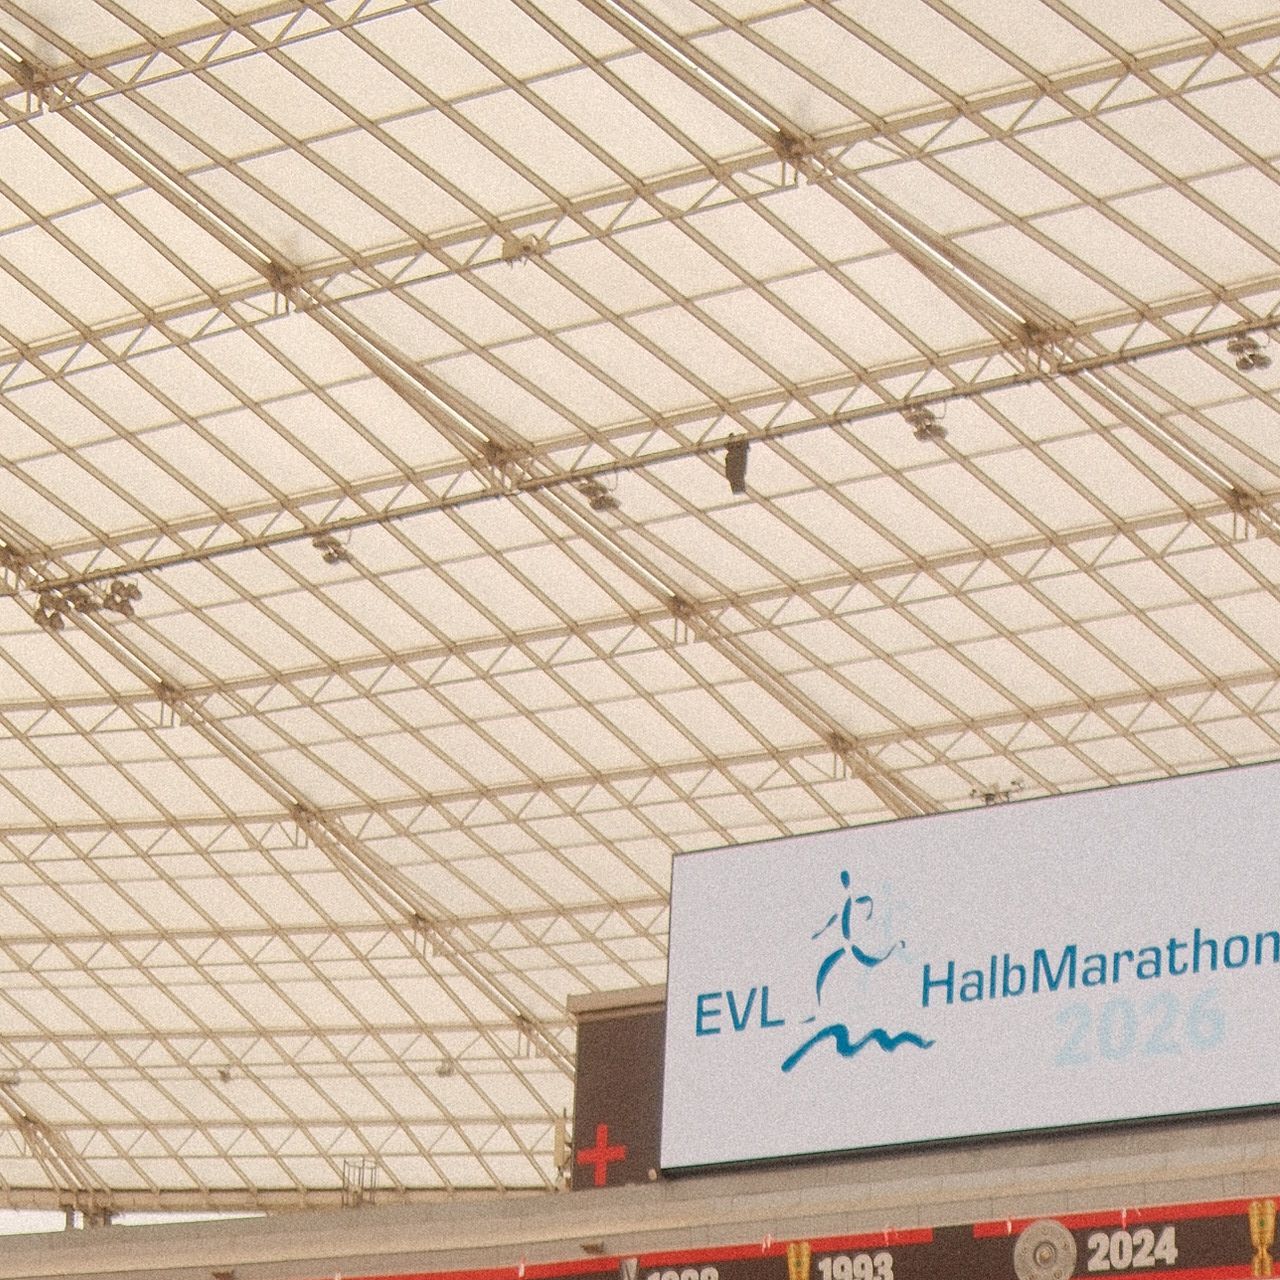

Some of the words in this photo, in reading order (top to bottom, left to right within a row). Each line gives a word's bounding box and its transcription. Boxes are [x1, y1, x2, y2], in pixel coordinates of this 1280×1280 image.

[695, 987, 786, 1036] EVL
[1055, 989, 1226, 1066] 2026
[1086, 1225, 1179, 1273] 2024
